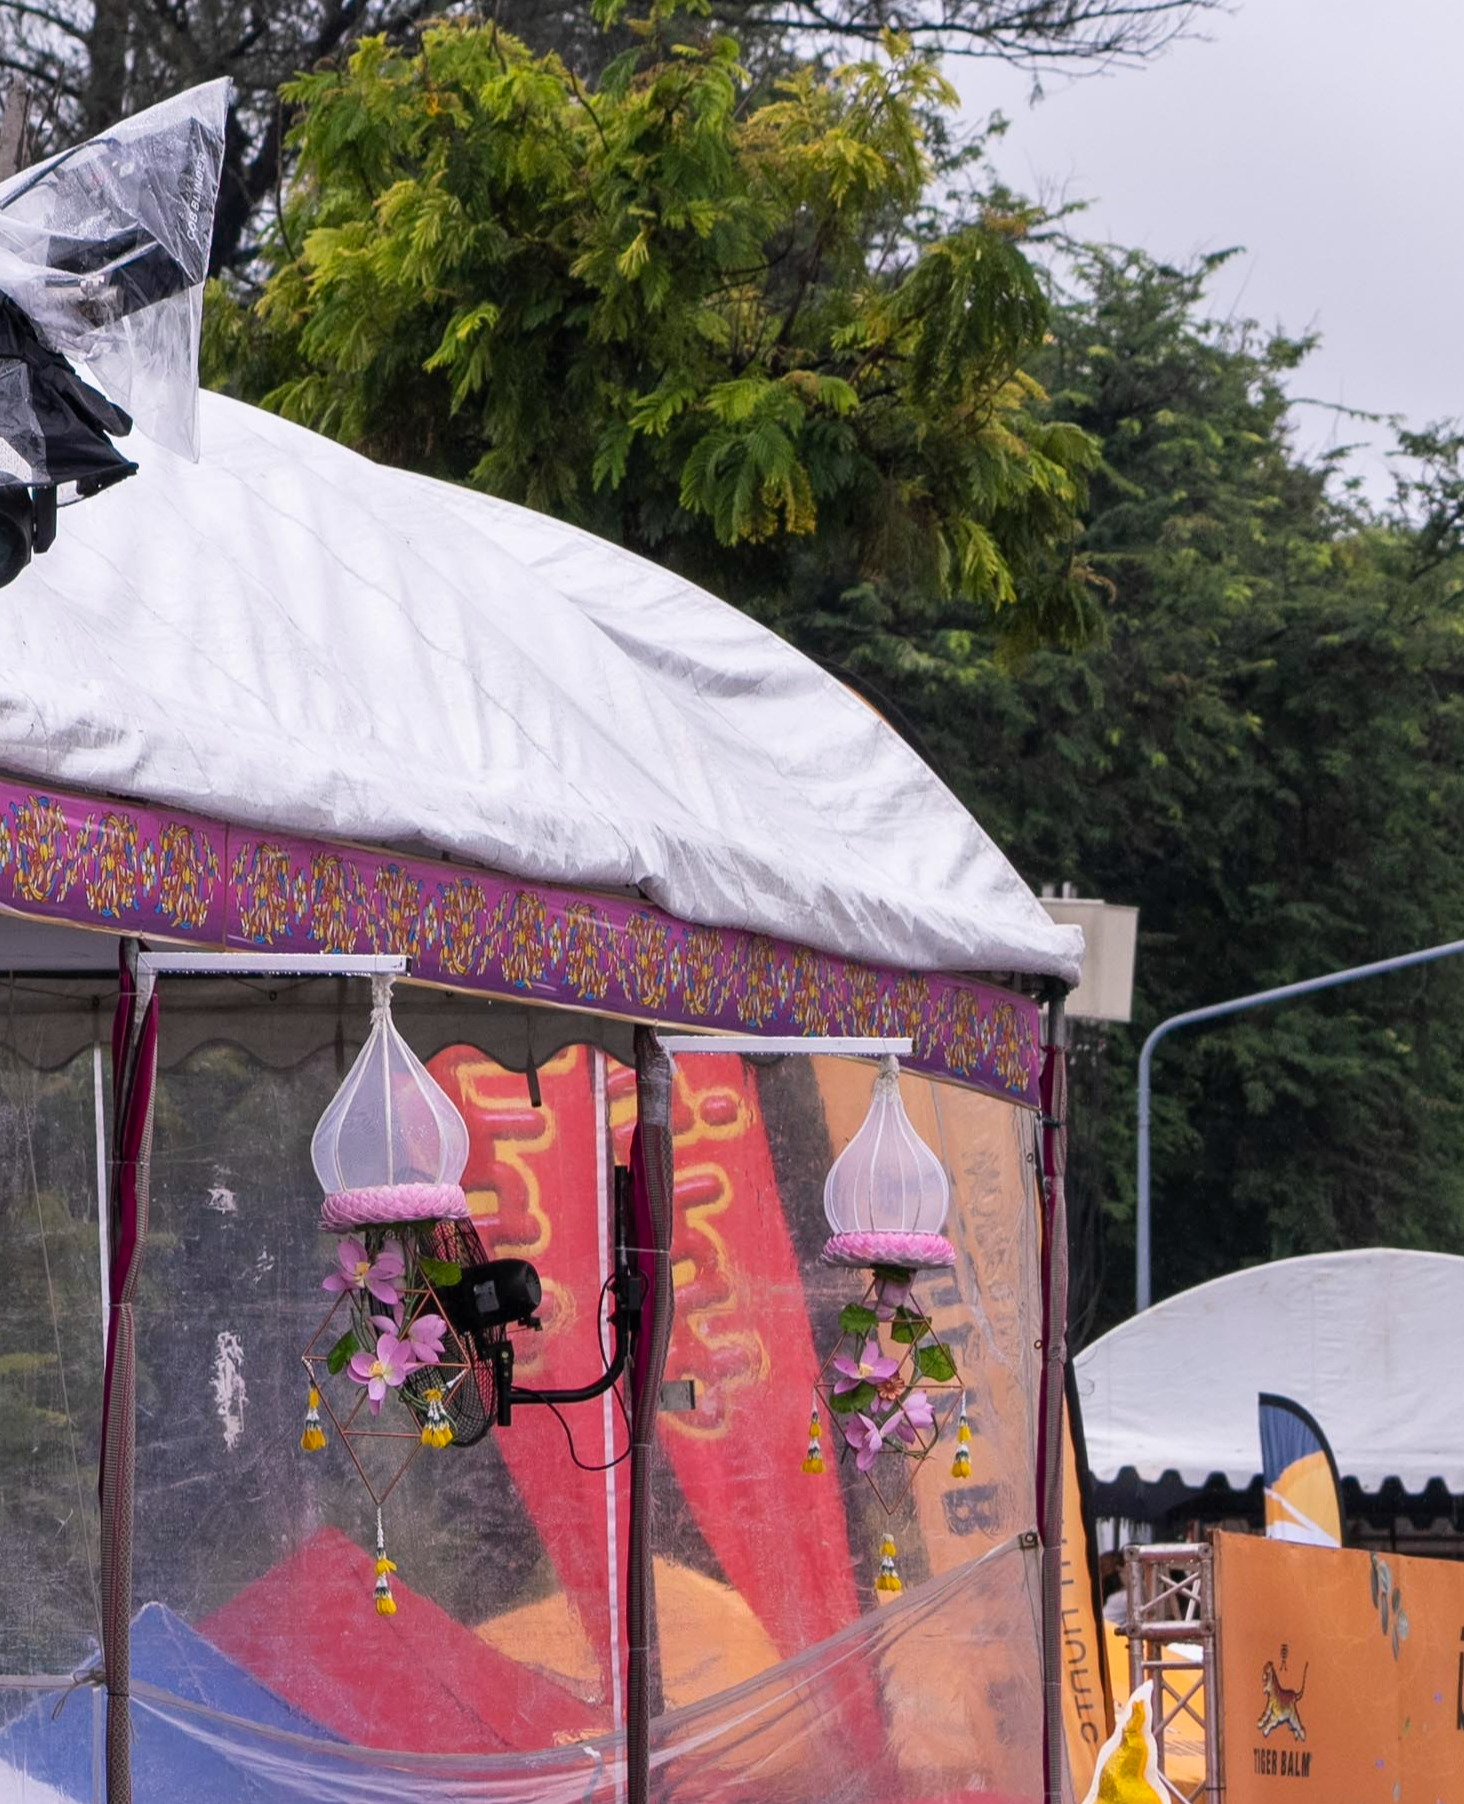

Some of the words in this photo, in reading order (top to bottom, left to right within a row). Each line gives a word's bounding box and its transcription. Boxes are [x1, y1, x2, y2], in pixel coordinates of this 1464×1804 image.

[190, 152, 207, 212] BLINDER
[186, 213, 199, 240] COB
[1253, 1748, 1278, 1777] TIGER
[1281, 1750, 1311, 1778] BALM
